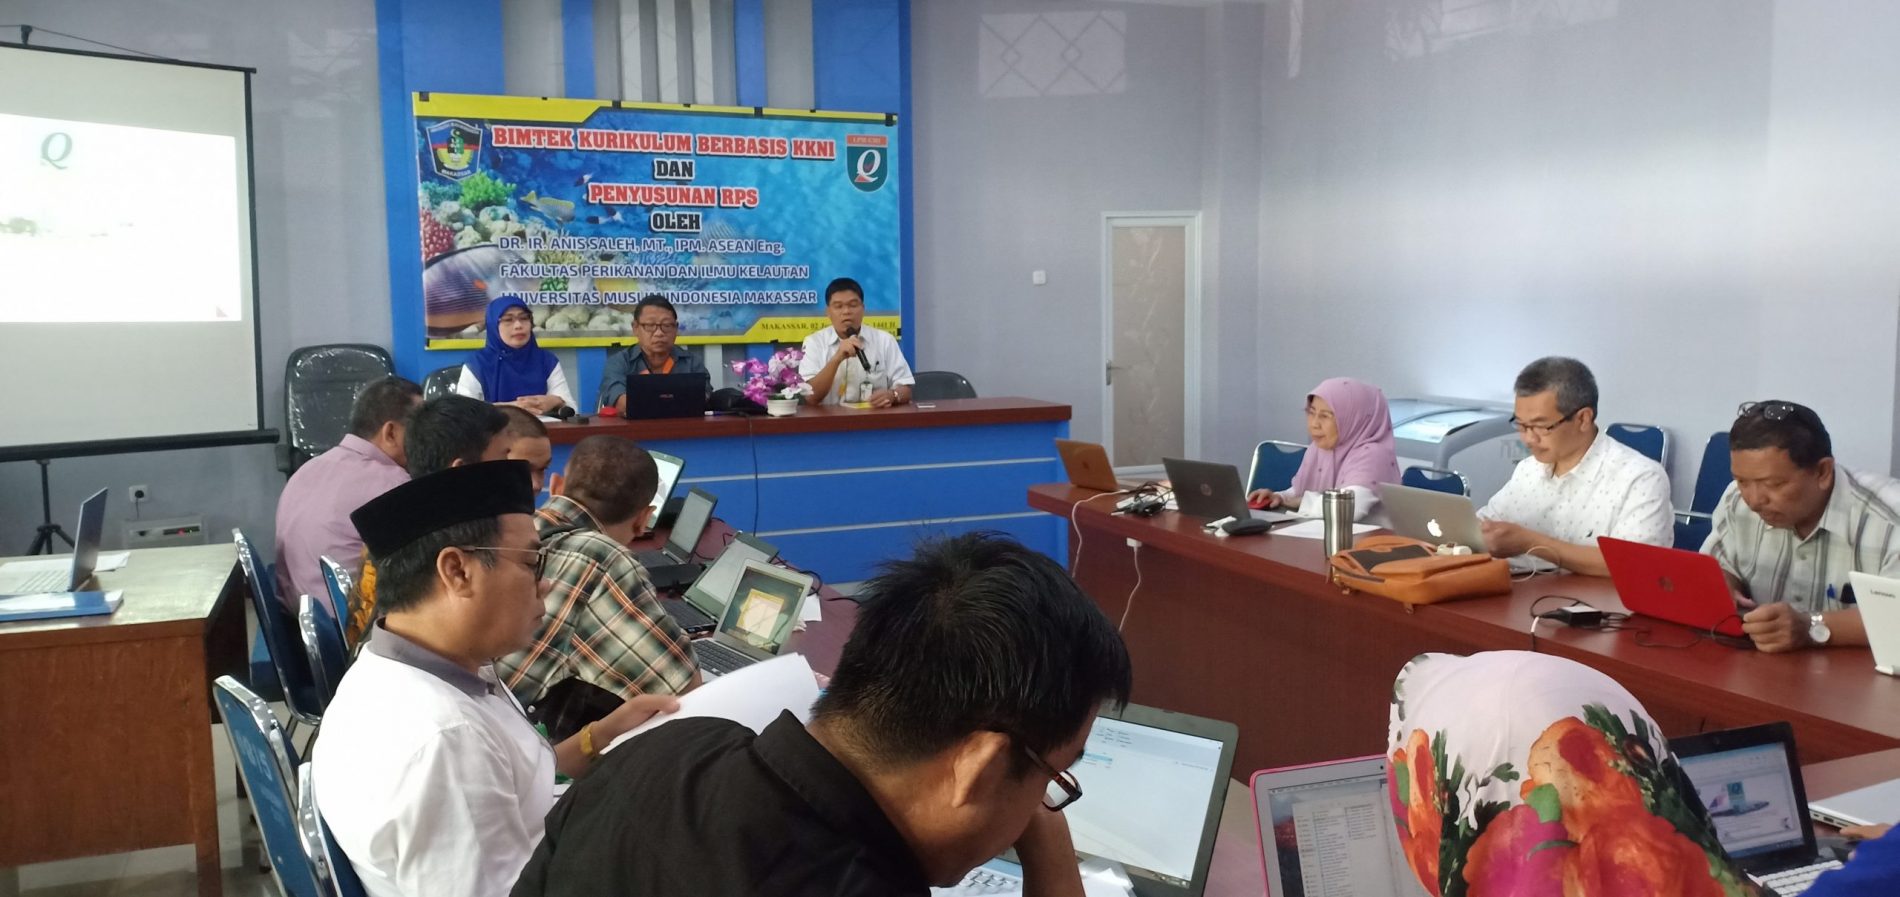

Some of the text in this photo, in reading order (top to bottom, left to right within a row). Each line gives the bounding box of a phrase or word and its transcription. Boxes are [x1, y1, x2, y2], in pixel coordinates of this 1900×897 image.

[41, 132, 73, 170] Q
[493, 126, 574, 148] BIMTEK
[577, 129, 692, 152] KURIKULUM
[696, 135, 788, 156] BERBASIS
[792, 139, 835, 158] KKNI
[656, 160, 694, 178] DAN
[856, 149, 881, 182] Q
[590, 184, 758, 206] PENYUSUNAN RPS
[652, 212, 701, 230] OLEH
[500, 237, 784, 255] DR. IR. ANIS SALEH, MT., IPM. ASEAN Eng.
[500, 265, 809, 279] FAKULTAS PERIKANAN DAN ILMU KELAUTAN
[667, 291, 739, 304] INDONESIA
[743, 291, 818, 304] MAKASSAR
